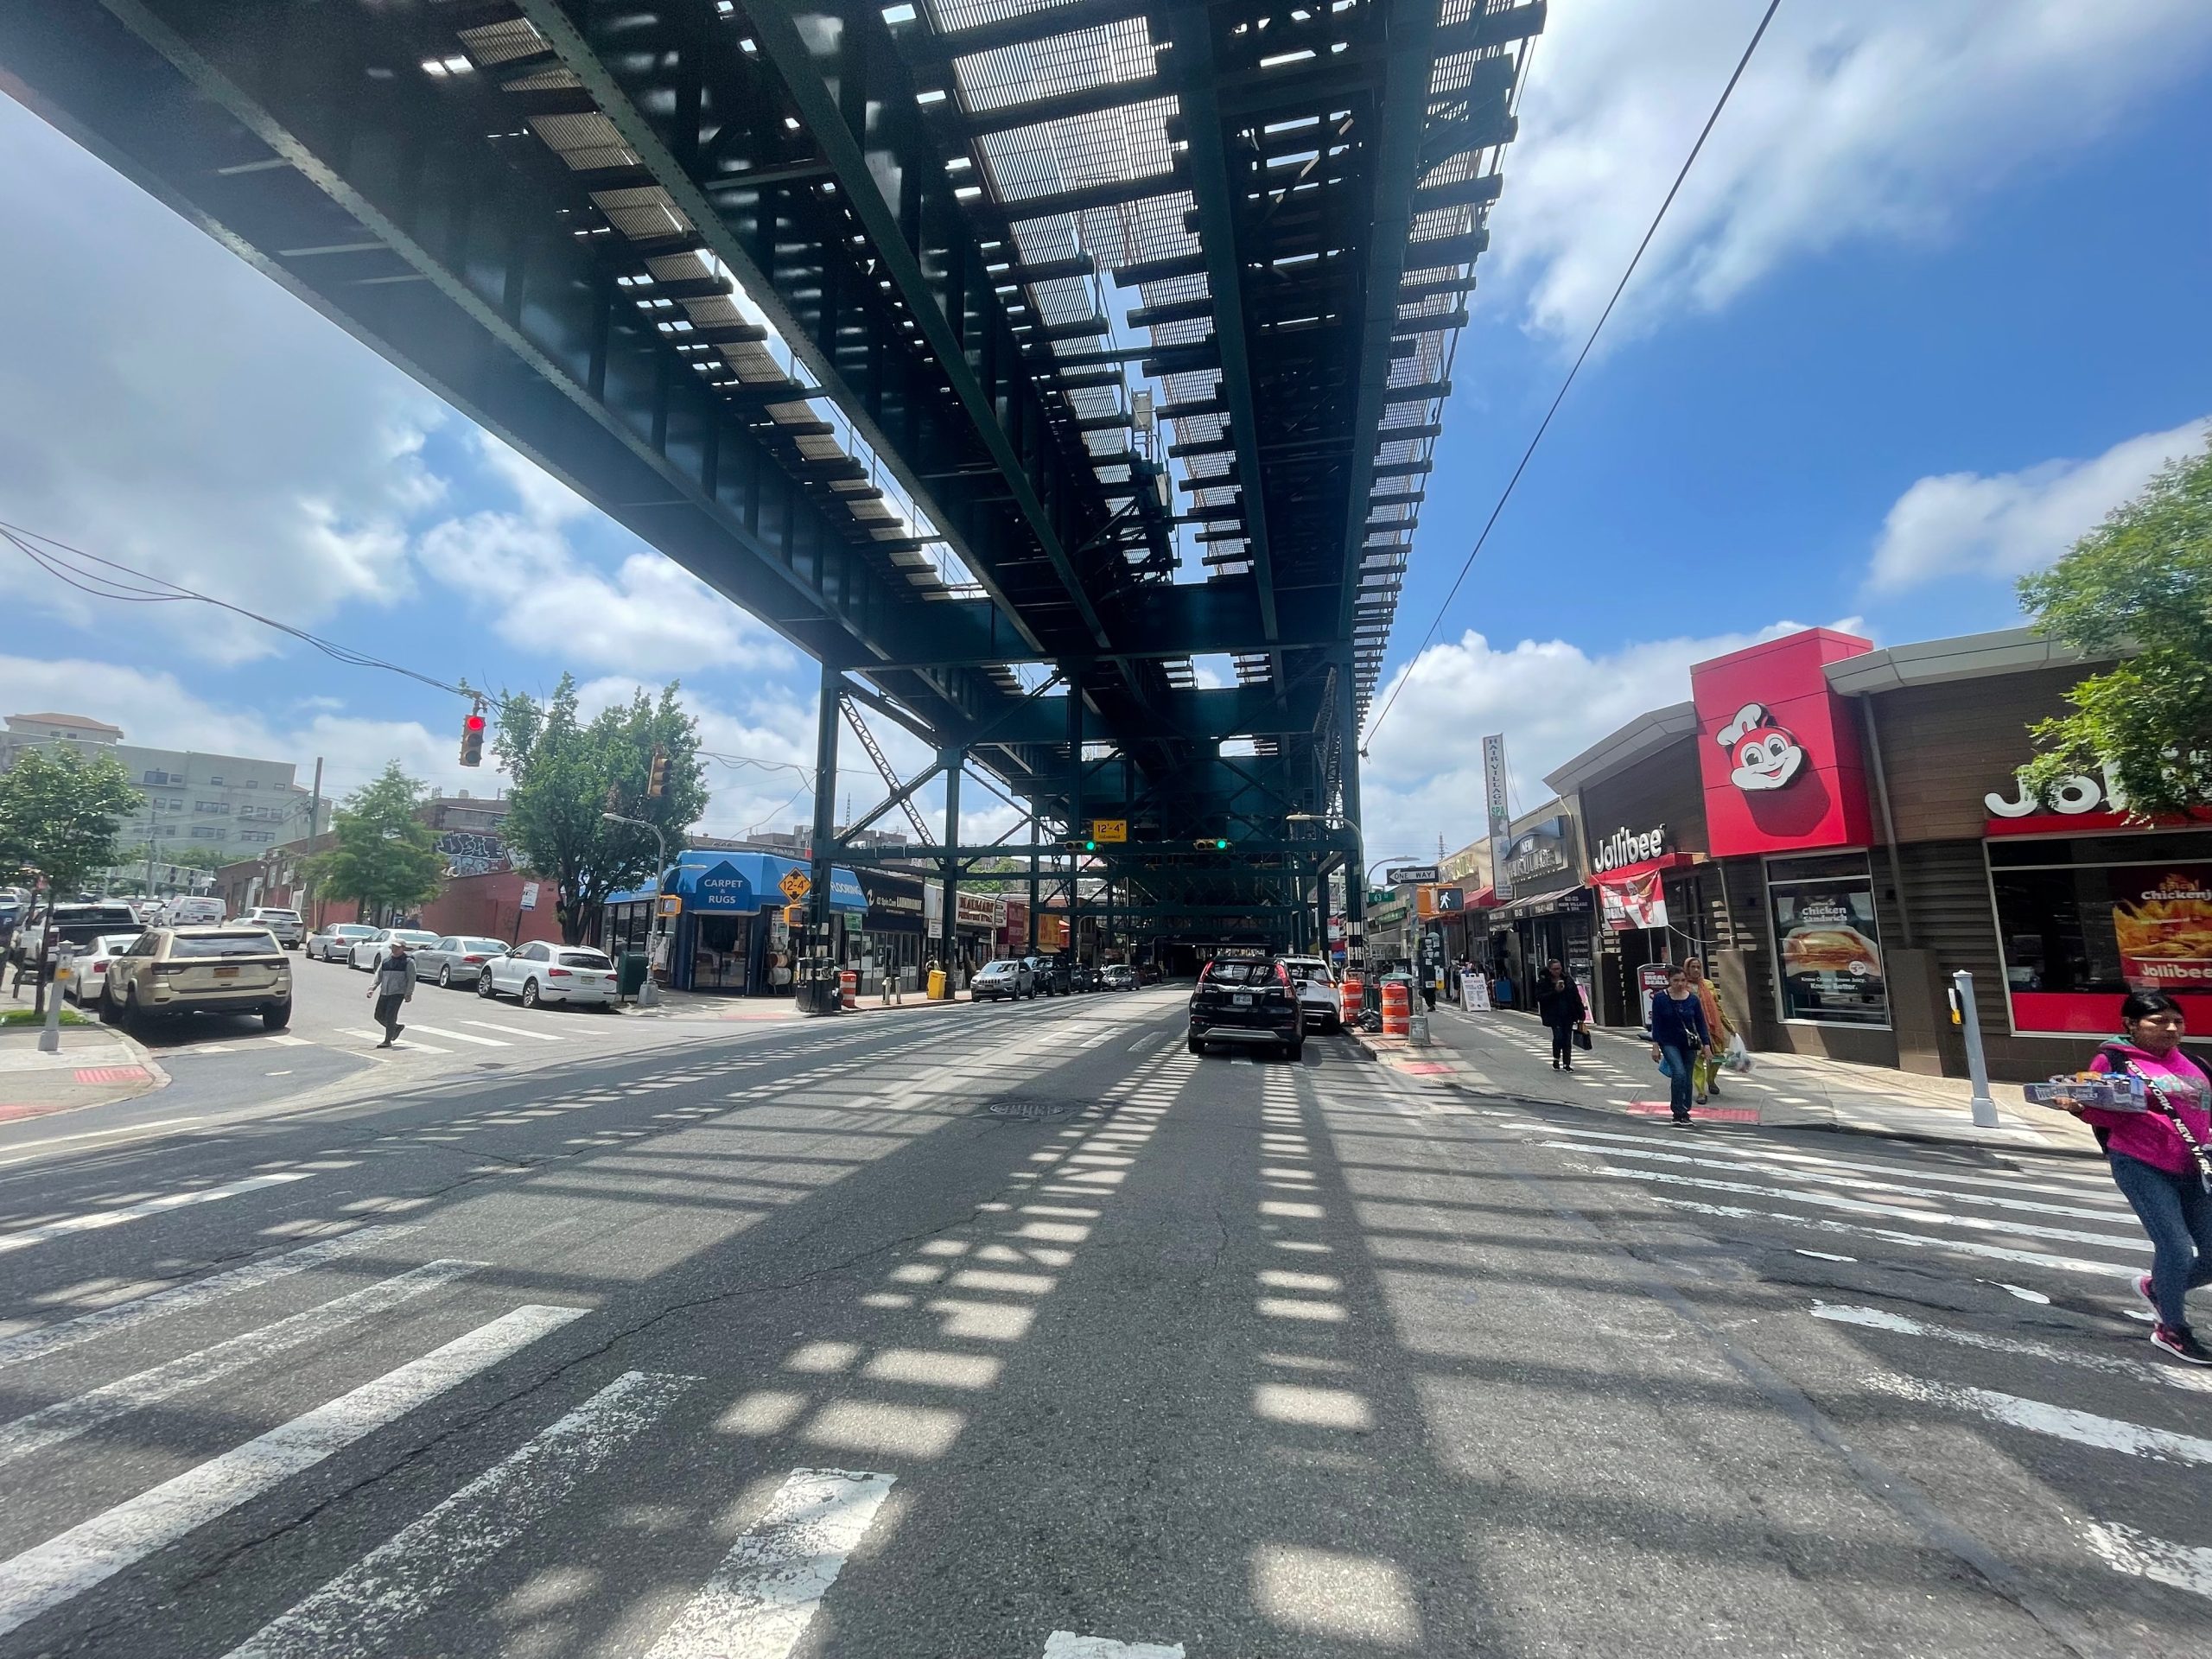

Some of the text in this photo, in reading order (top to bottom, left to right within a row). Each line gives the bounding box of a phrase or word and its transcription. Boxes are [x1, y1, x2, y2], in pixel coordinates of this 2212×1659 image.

[1491, 806, 1507, 817] SPA
[1594, 826, 1662, 874] Jollibee
[704, 879, 744, 888] CARPET
[830, 881, 862, 896] FLOORING
[709, 895, 736, 904] RUGS
[1374, 893, 1382, 902] 63
[1802, 907, 1847, 916] Chicken
[2141, 963, 2212, 978] Jollibee
[2125, 1059, 2174, 1111] NEW YORK
[2172, 1118, 2196, 1143] NEW
